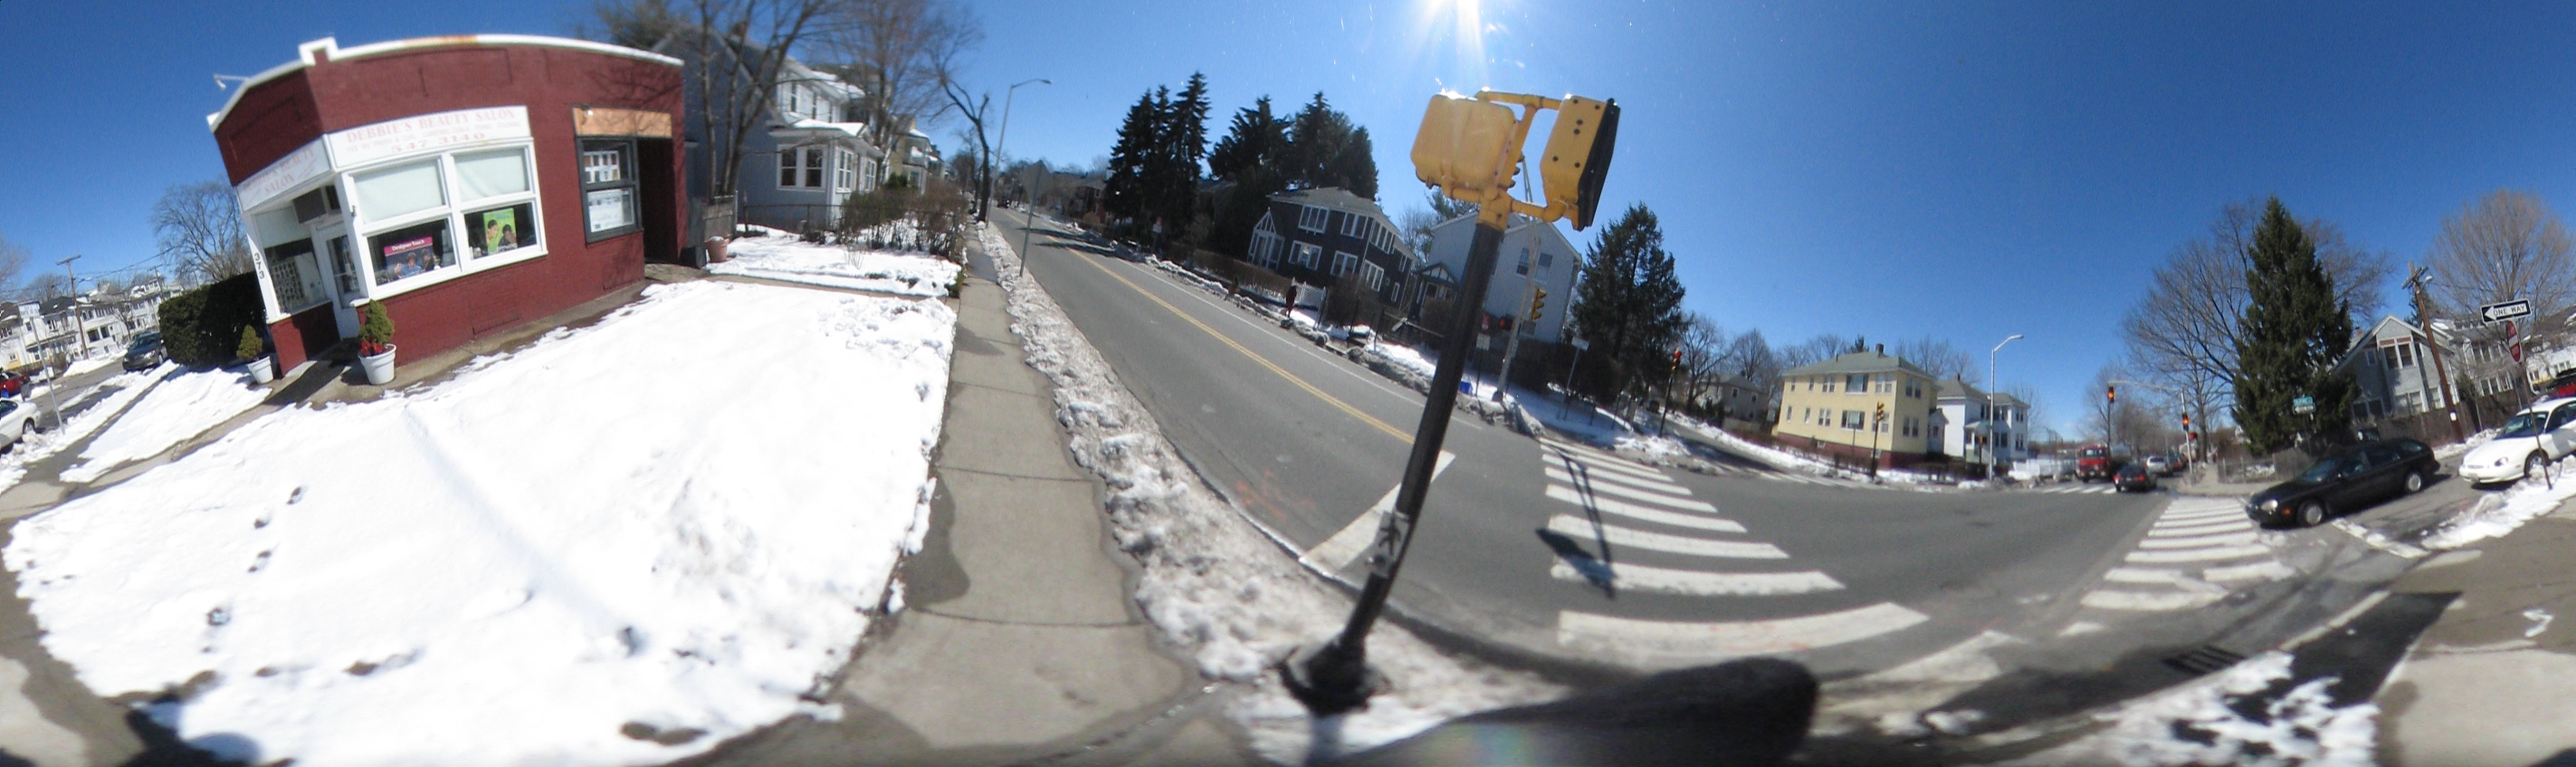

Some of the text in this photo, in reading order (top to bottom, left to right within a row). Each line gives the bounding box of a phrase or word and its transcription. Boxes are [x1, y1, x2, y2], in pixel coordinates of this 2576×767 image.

[419, 113, 469, 129] BEAUTY
[475, 109, 515, 121] SALON
[254, 253, 264, 279] 373
[2494, 305, 2525, 316] ONE WAY
